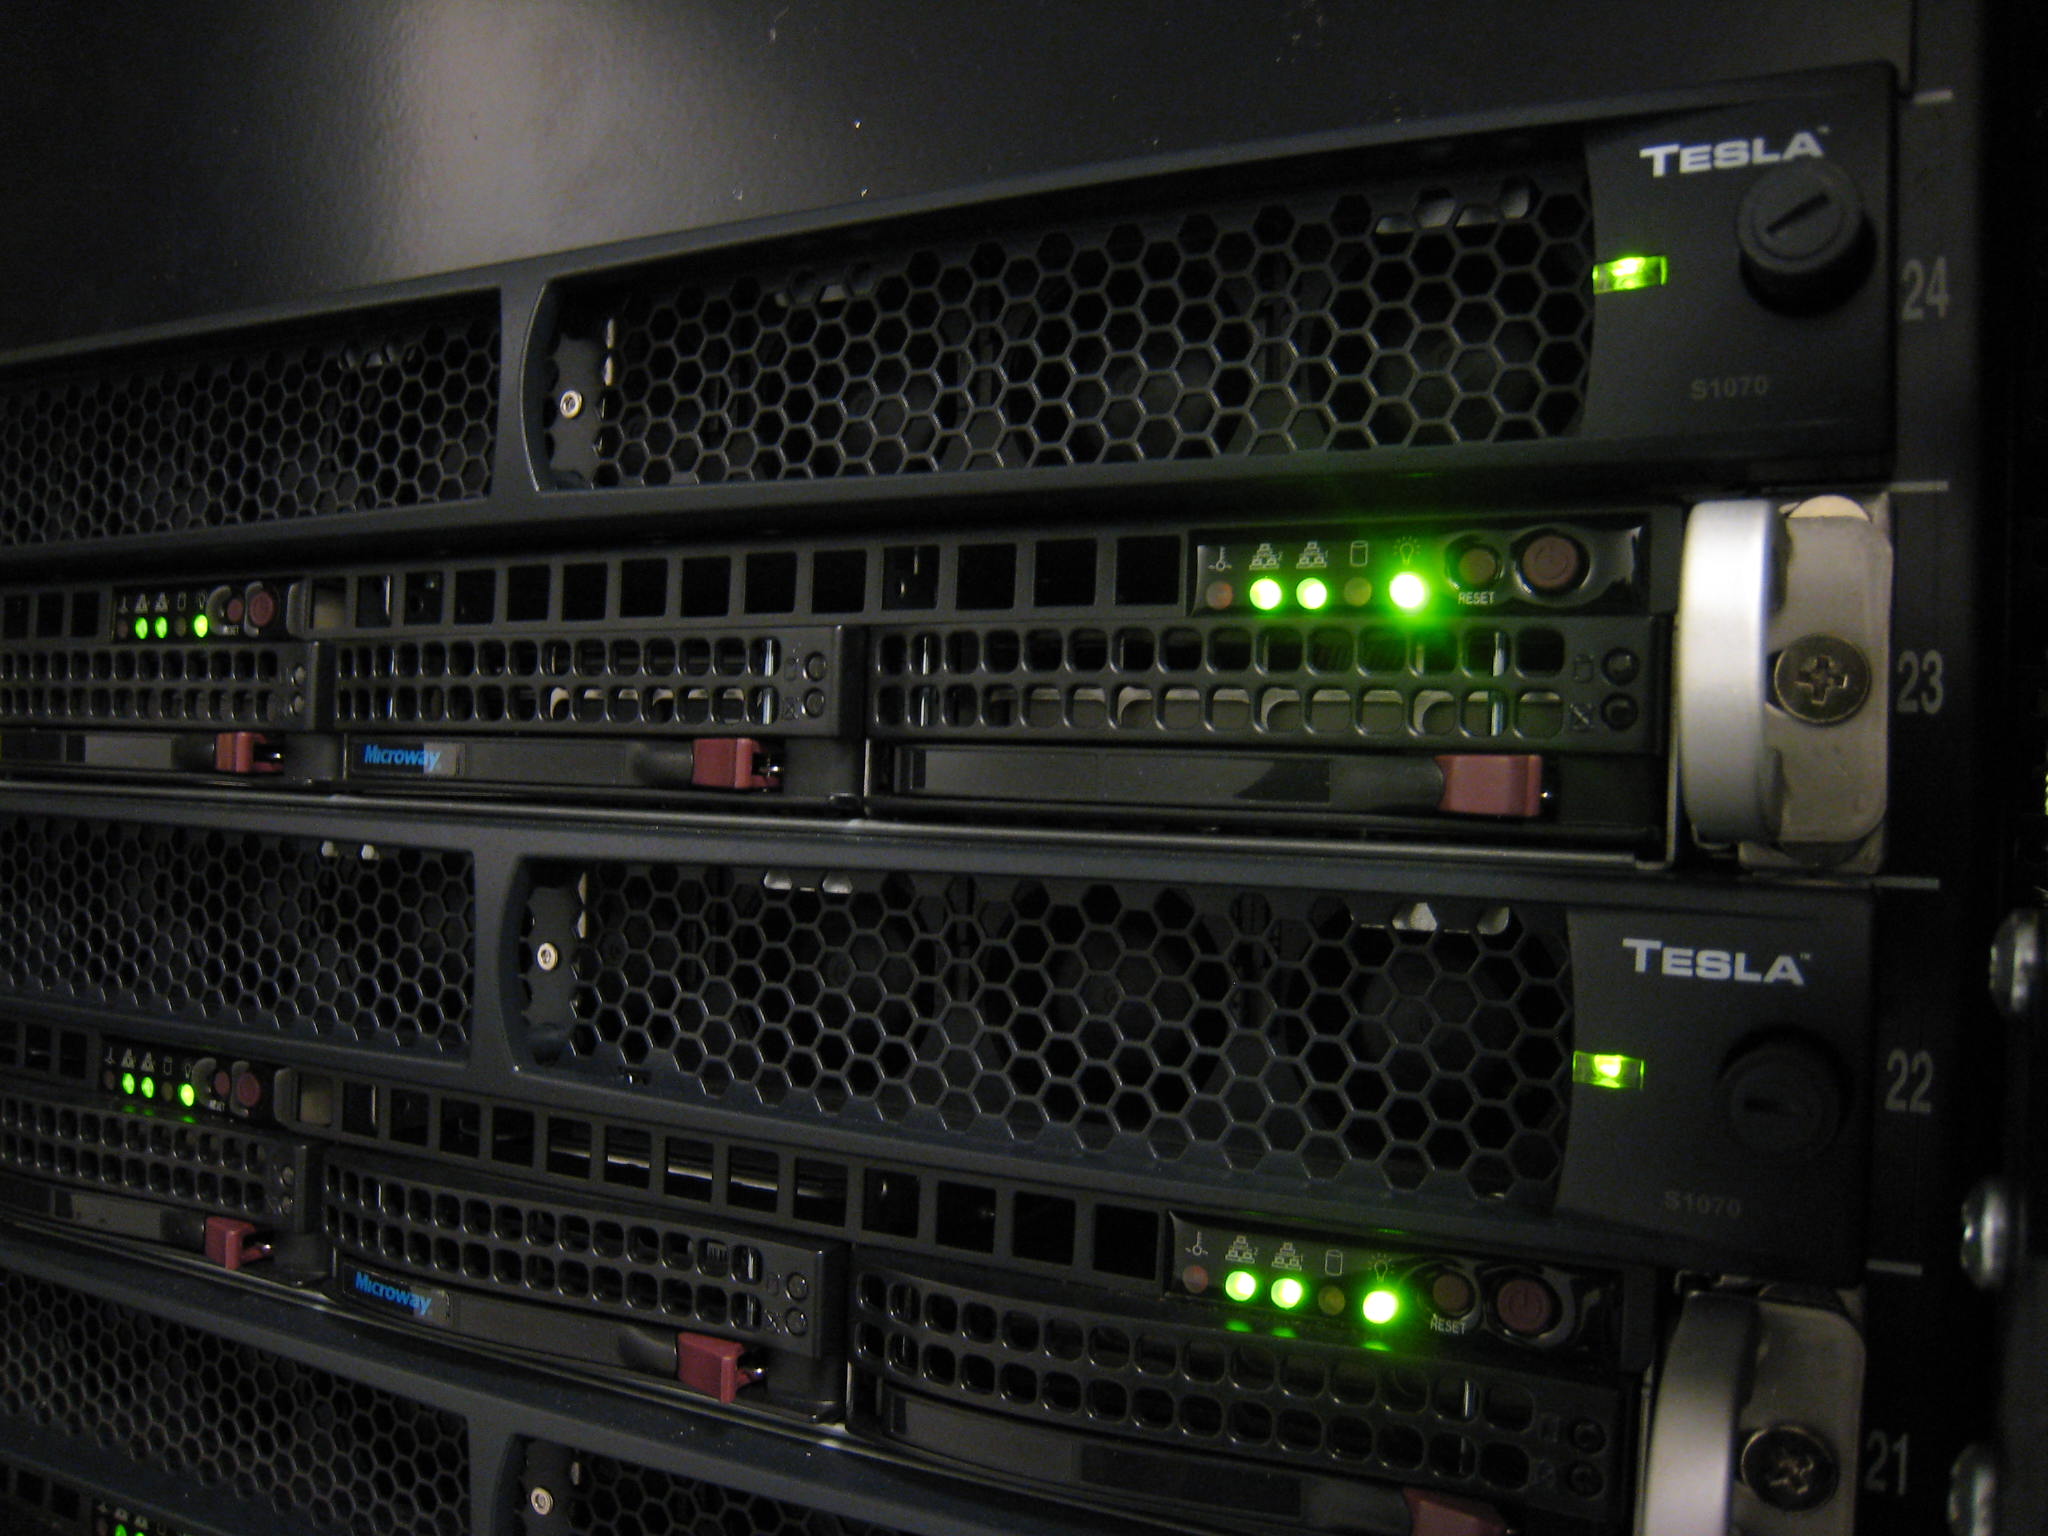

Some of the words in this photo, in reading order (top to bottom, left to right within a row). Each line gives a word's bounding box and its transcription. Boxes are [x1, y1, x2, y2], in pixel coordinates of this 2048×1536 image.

[1639, 131, 1825, 178] TESLA
[1902, 256, 1949, 320] 24
[1691, 375, 1768, 400] S1070
[1458, 591, 1495, 605] RESET
[1896, 649, 1944, 715] 23
[363, 743, 441, 772] Microway
[1622, 937, 1805, 986] TESLA
[1885, 1048, 1934, 1114] 22
[1664, 1190, 1742, 1217] S1070
[354, 1271, 432, 1316] Microway
[1430, 1313, 1465, 1336] RESET
[1864, 1428, 1910, 1497] 21
